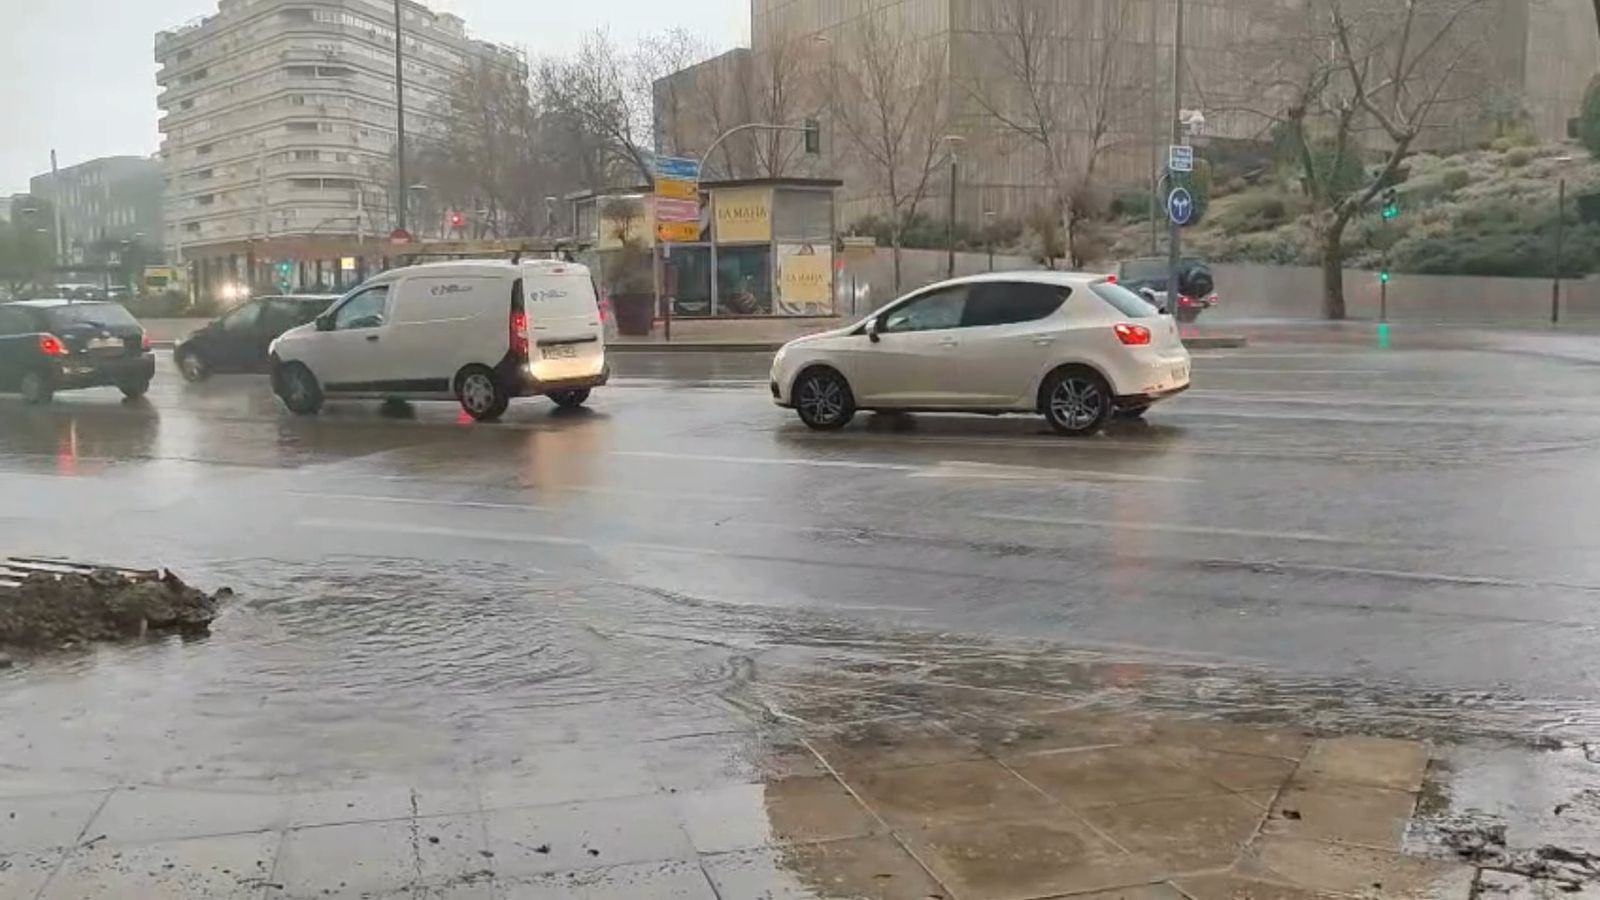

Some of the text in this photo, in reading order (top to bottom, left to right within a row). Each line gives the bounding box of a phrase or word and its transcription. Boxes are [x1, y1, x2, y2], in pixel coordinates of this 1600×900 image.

[718, 205, 768, 220] LA MAFIA
[786, 273, 797, 283] LA
